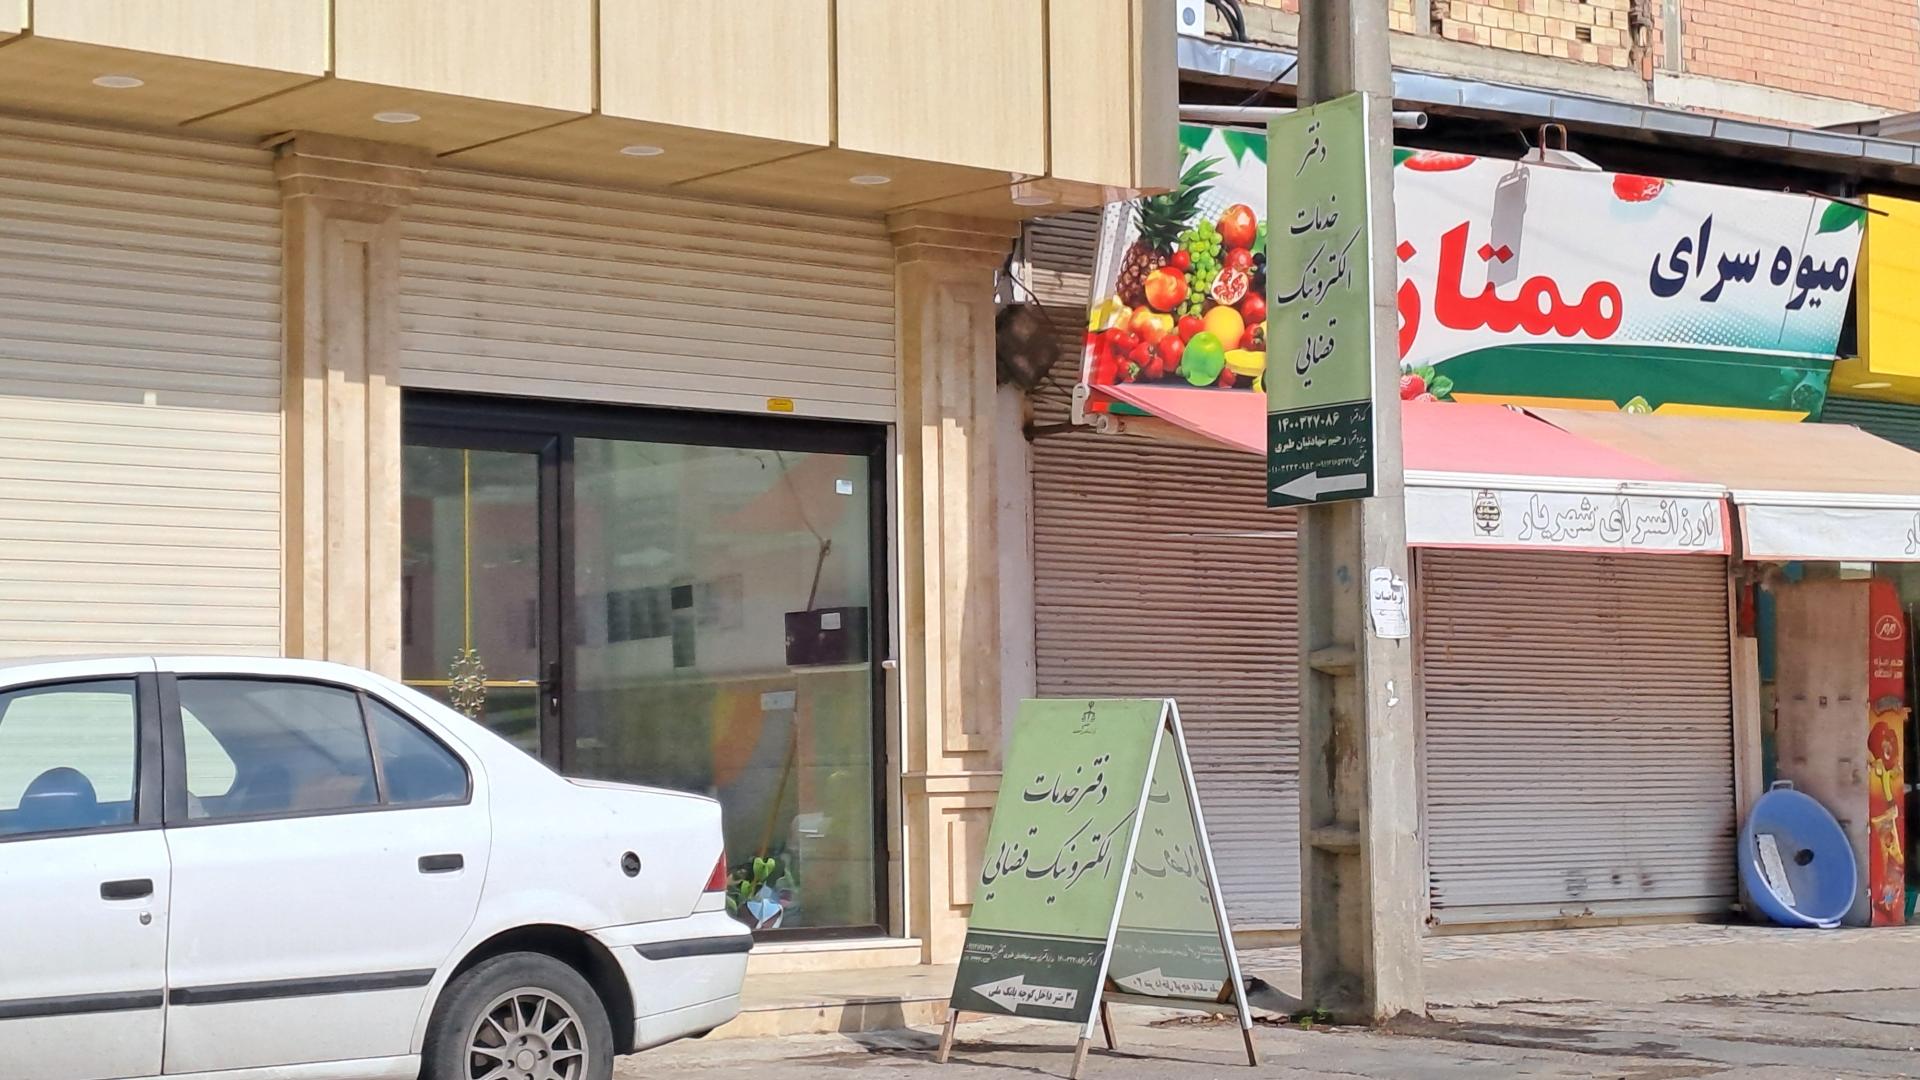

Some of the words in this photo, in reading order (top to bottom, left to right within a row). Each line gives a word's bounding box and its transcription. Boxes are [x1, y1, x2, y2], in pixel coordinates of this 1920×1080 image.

[1296, 121, 1327, 176] دفتر
[1290, 195, 1339, 235] خدمات
[1277, 227, 1362, 320] الکترونیک
[1650, 214, 1760, 302] سرای
[1770, 243, 1850, 310] میوه
[1518, 494, 1598, 542] شهریار
[1023, 766, 1081, 804] خدمات
[1067, 755, 1110, 813] دفتر
[1025, 808, 1138, 904] الکترونیک
